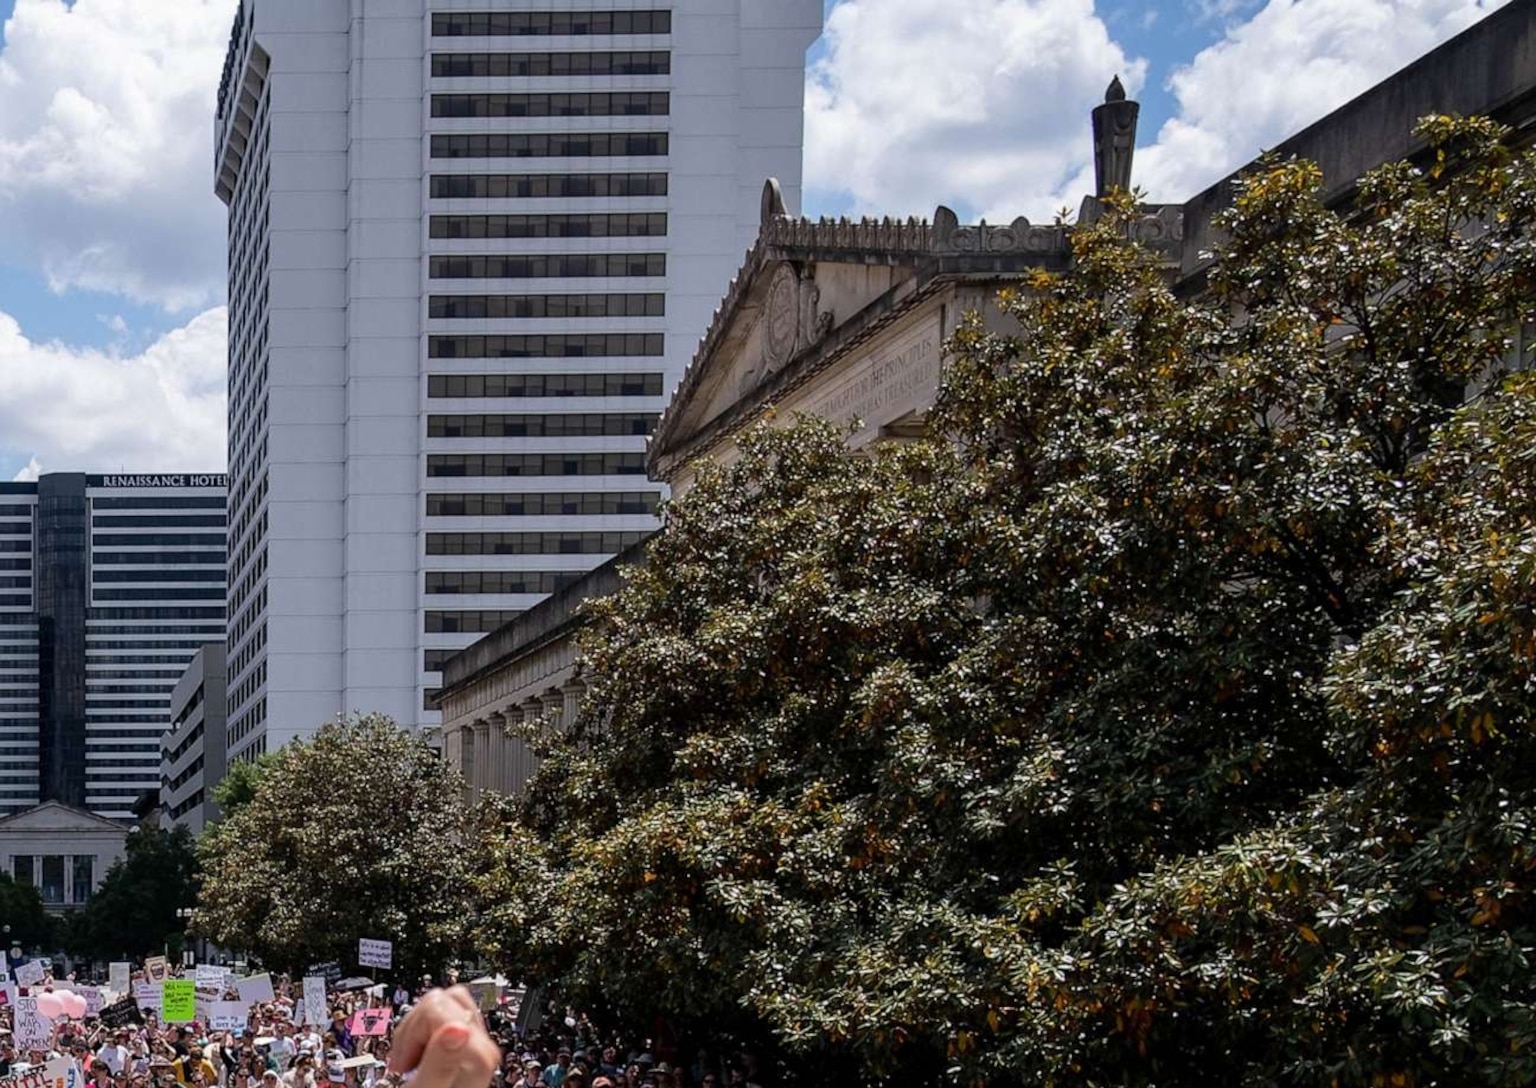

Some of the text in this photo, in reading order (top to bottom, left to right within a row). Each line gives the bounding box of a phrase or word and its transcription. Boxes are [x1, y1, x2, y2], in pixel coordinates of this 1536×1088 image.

[104, 475, 228, 487] RENAISSANCE HOTEL
[17, 999, 38, 1011] STO
